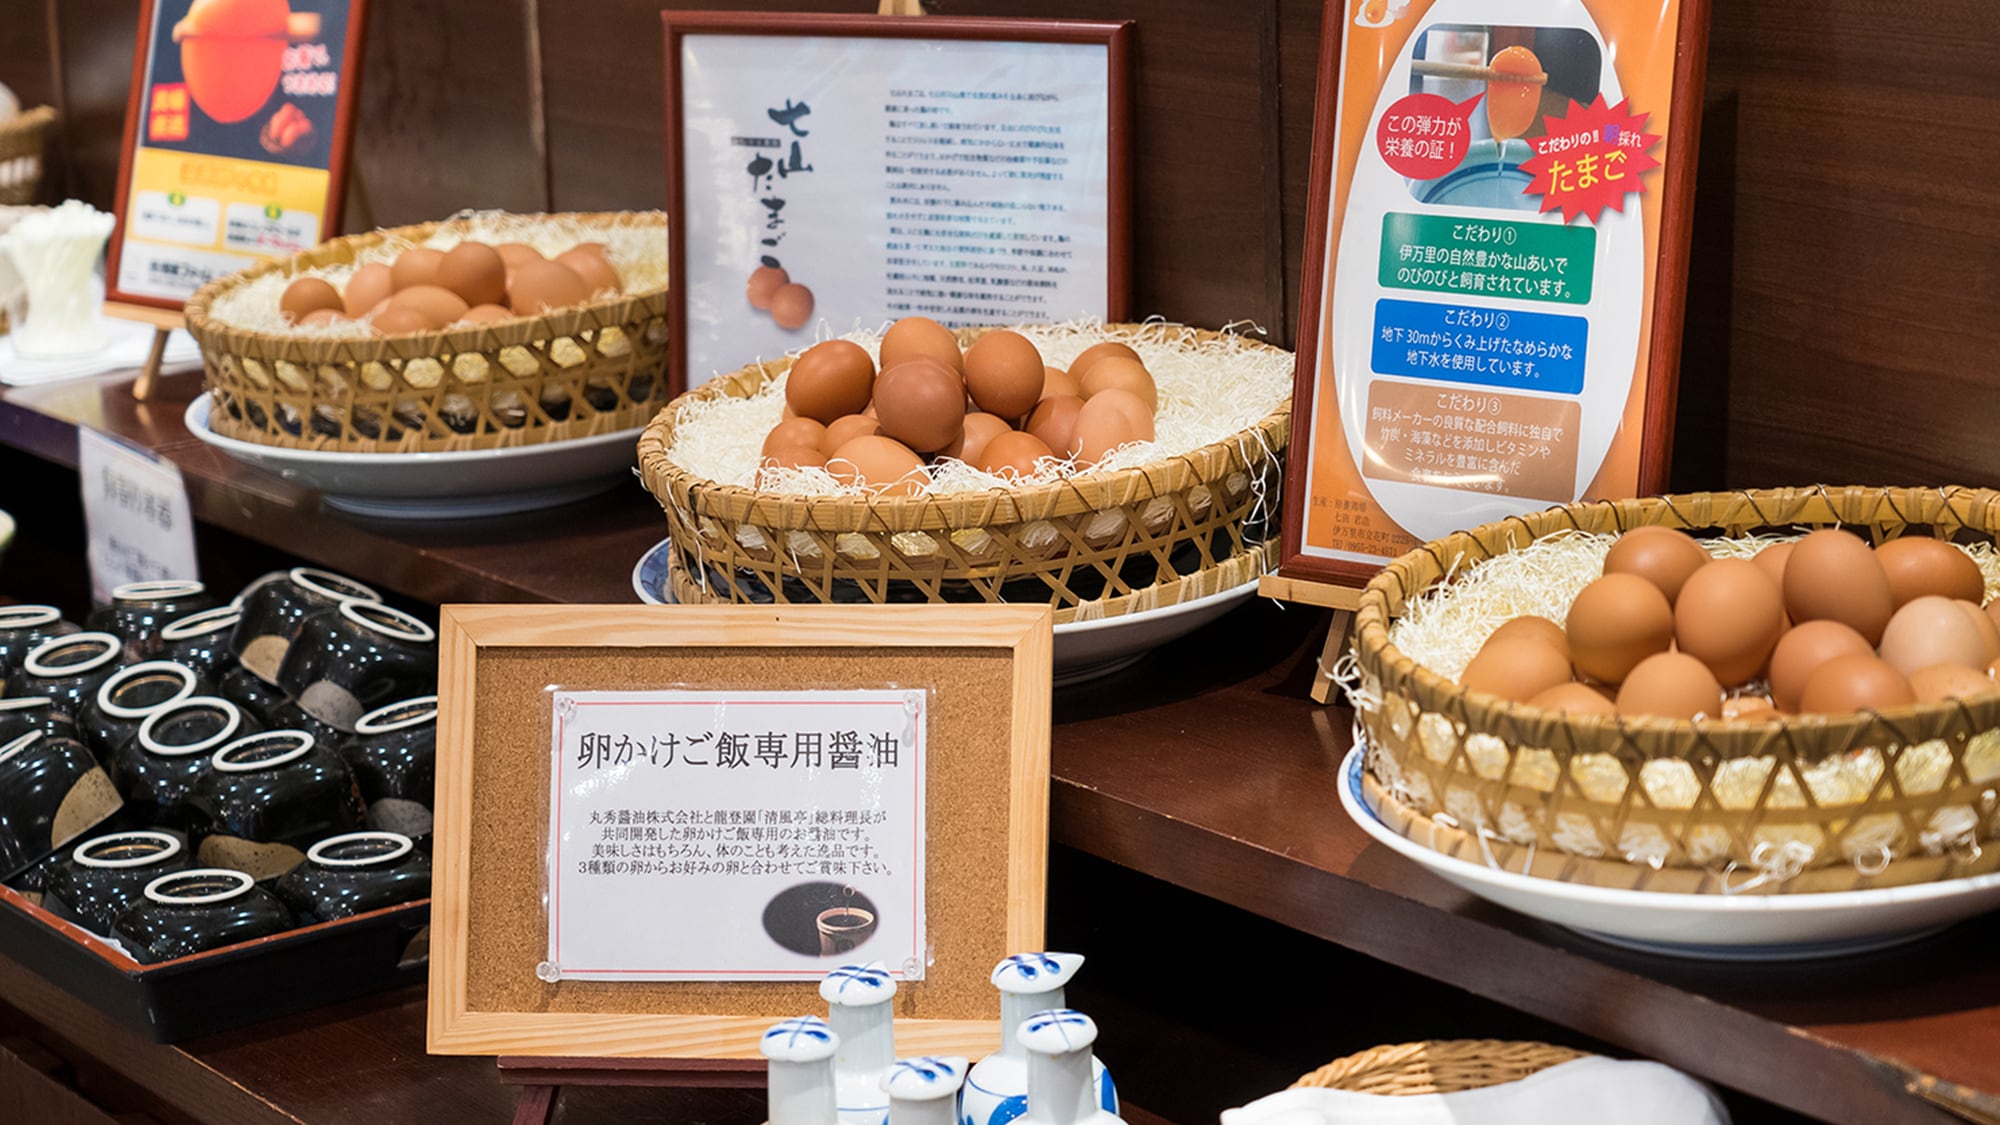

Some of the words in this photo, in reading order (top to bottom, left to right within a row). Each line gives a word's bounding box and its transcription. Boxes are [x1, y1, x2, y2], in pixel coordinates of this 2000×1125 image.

[1387, 115, 1462, 137] この弾力が
[1384, 137, 1455, 160] 栄養の証！
[1547, 150, 1627, 195] たまご
[1452, 223, 1517, 246] こだわり①
[1400, 245, 1569, 275] 伊万里の自然豊かな山あいで
[1397, 267, 1572, 298] のびのびと飼育されています。
[1444, 309, 1511, 331] こだわり②
[1406, 350, 1541, 378] 地下水を使用しています。
[1371, 406, 1564, 442] 飼料メーカーの良質な配合飼料に独自で
[1404, 447, 1521, 476] ミネラルを豊富に含んだ
[577, 730, 899, 770] 卵かけご飯専用醤油
[601, 826, 870, 842] 共同開発した卵かけご飯専用のお醤油です。
[591, 843, 879, 859] 美味しさはもちろん、体のことも考えた逸品です。
